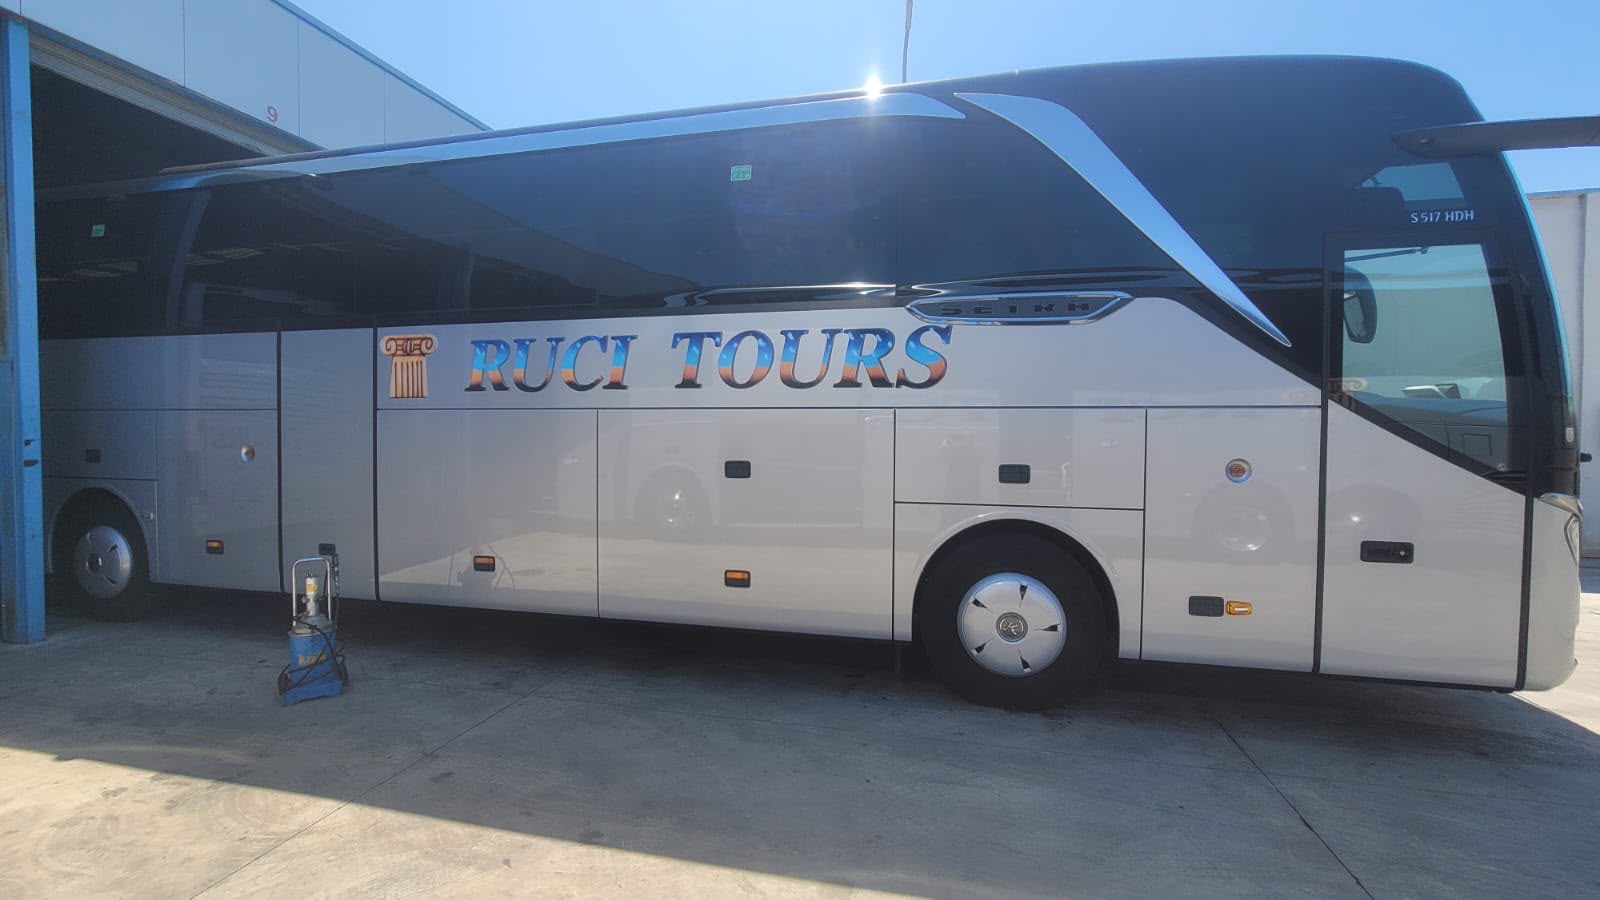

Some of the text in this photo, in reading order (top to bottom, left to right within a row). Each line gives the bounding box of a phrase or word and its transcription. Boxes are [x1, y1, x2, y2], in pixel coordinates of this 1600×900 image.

[267, 105, 278, 122] 9
[1410, 209, 1474, 223] S 517 HDH
[465, 325, 953, 392] RUCI TOURS
